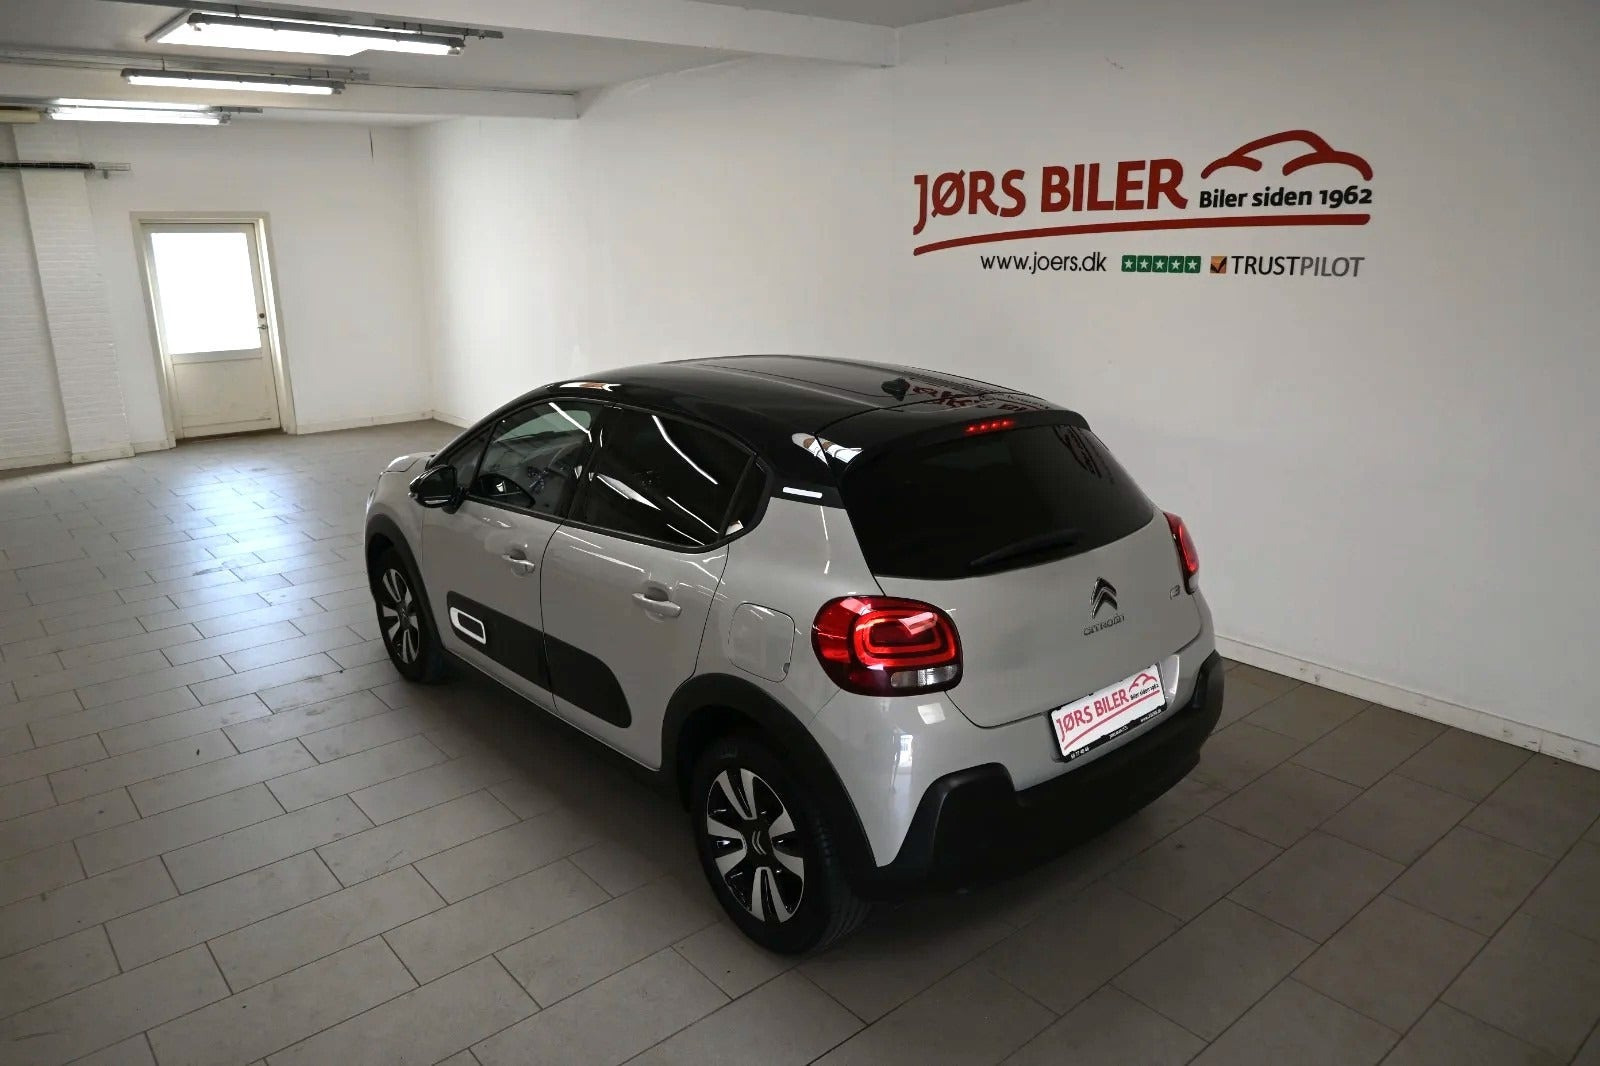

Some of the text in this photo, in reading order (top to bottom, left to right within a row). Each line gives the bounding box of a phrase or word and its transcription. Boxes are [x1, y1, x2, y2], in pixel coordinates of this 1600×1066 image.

[912, 157, 1189, 236] JØRS BILER
[1199, 186, 1373, 209] Biler siden 1962
[979, 251, 1107, 274] www.joers.dk
[1230, 255, 1366, 278] TRUSTPILOT
[1056, 705, 1093, 742] JØRS
[1094, 688, 1129, 717] BILER
